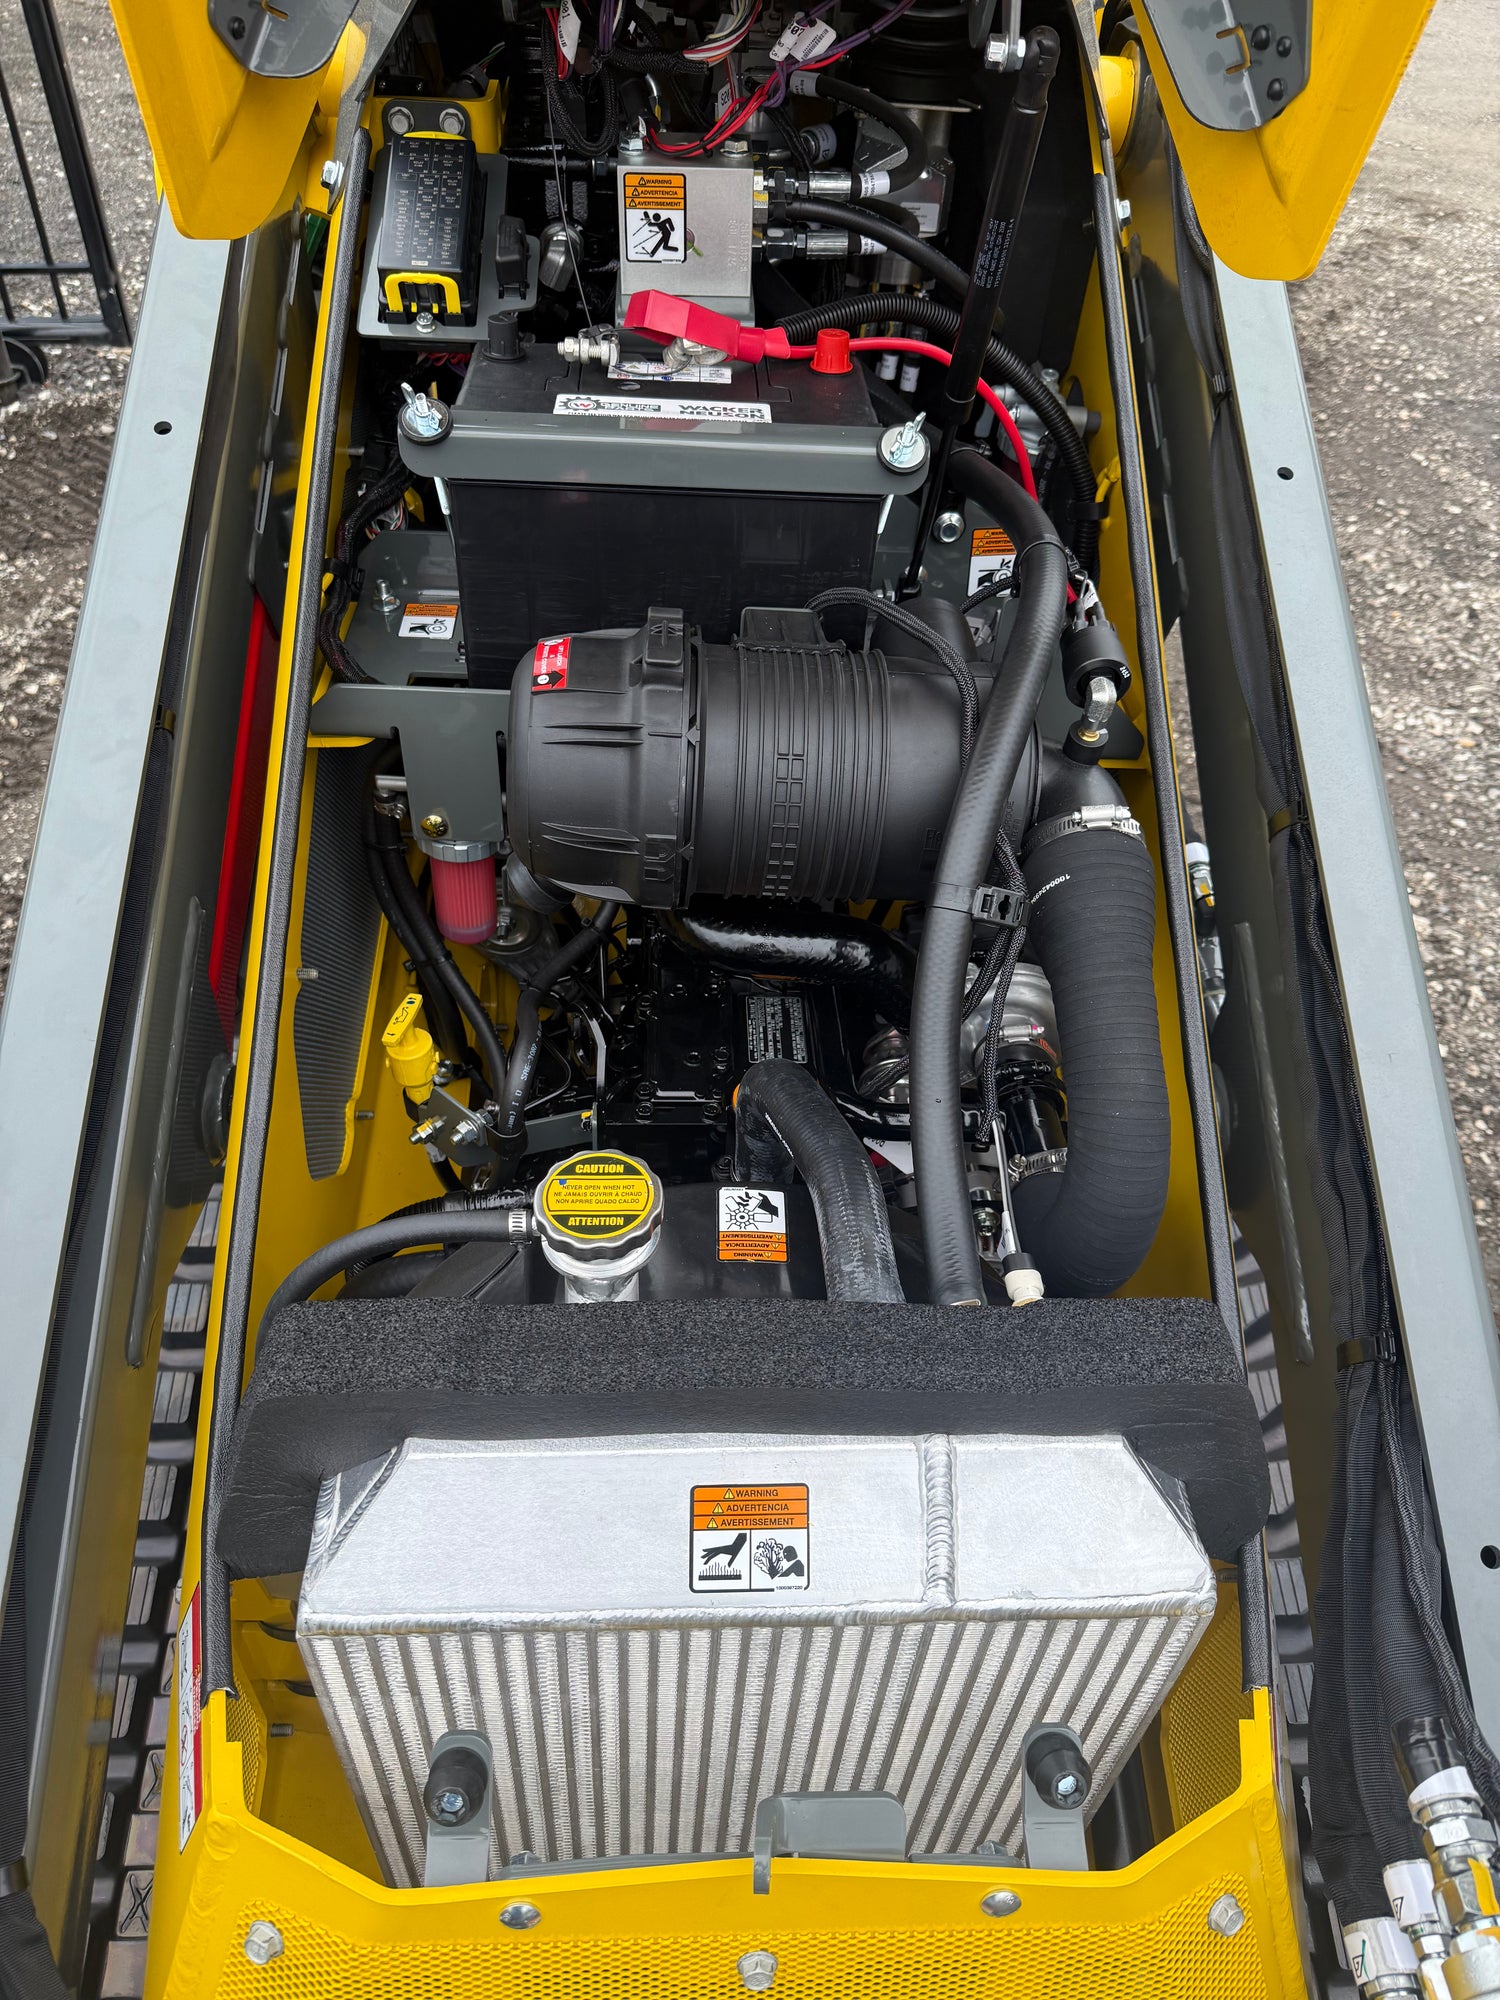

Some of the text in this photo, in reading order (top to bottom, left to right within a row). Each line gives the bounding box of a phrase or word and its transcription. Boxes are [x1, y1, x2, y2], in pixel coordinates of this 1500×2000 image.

[678, 404, 763, 414] WACKER
[679, 411, 765, 419] NEUSON
[575, 1164, 625, 1173] CAUTION
[568, 1217, 624, 1226] ATTENTION
[736, 1489, 779, 1497] WARNING
[726, 1503, 789, 1512] ADVERTENCIA
[720, 1517, 795, 1527] AVERTISSEMENT
